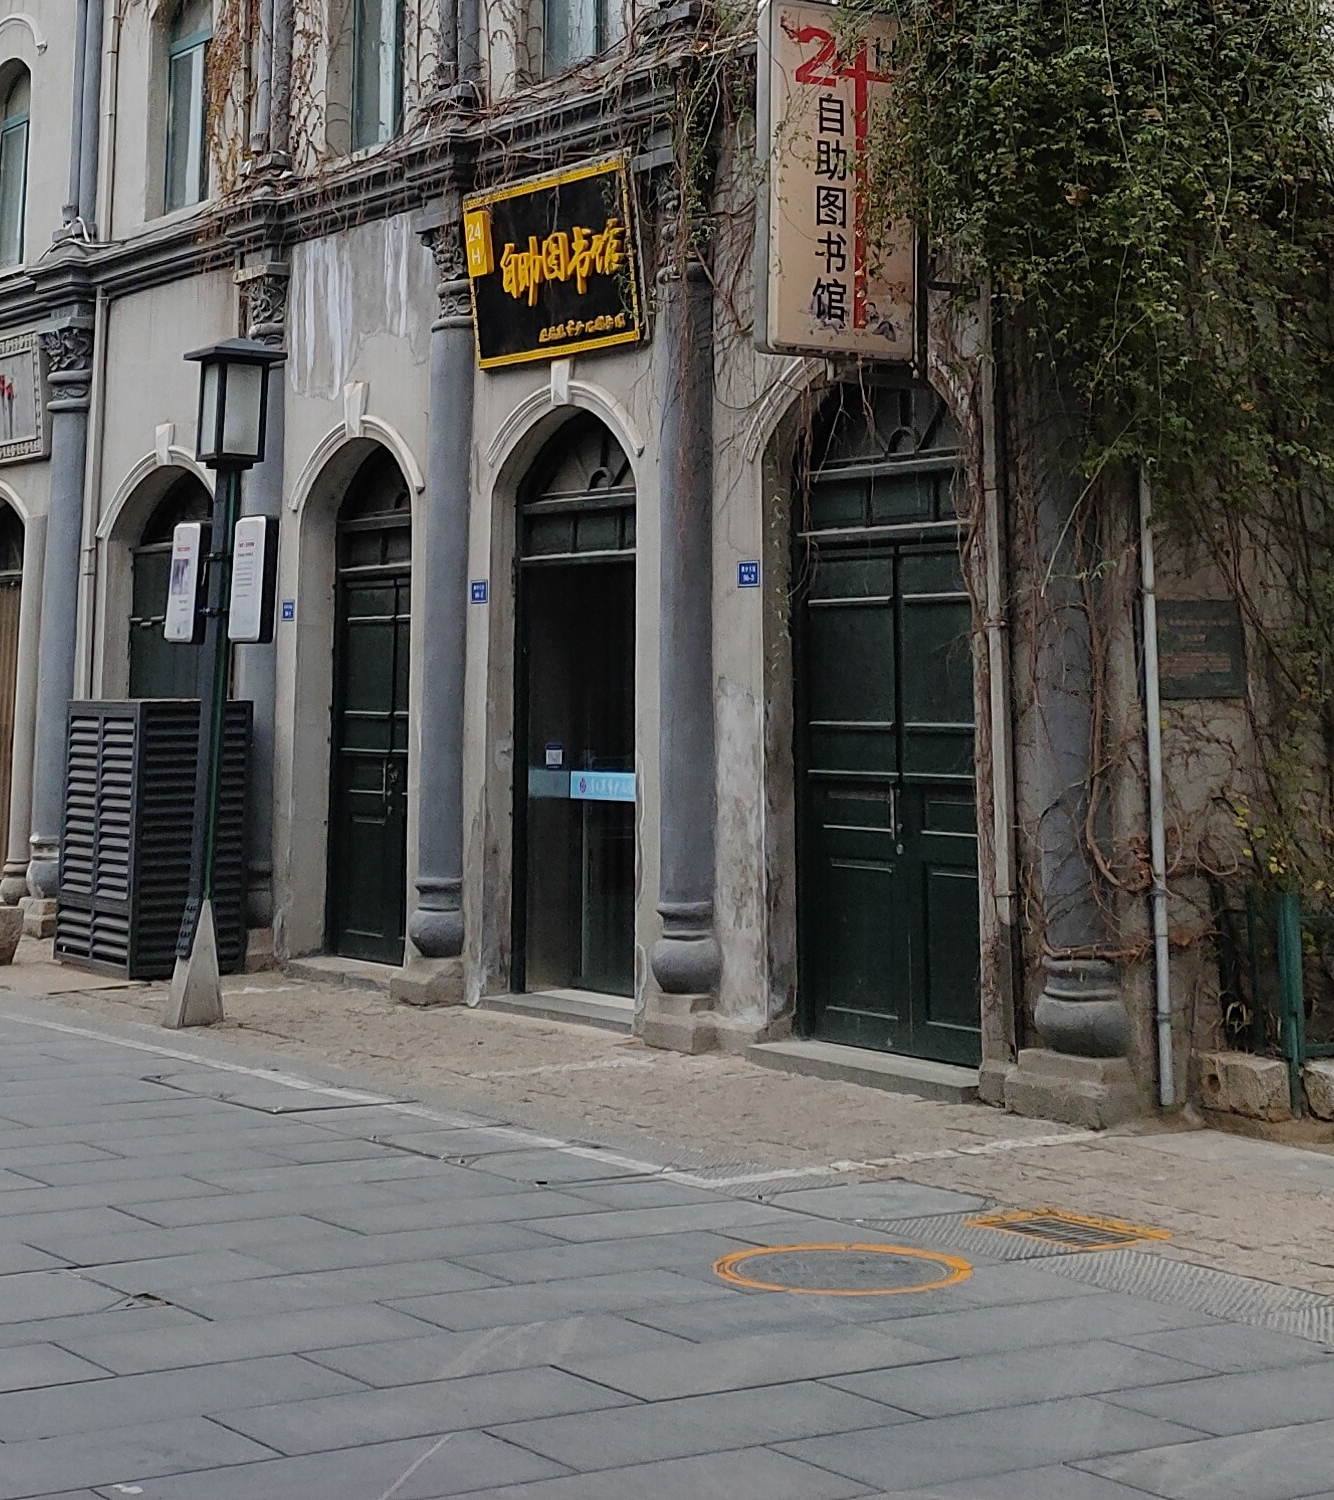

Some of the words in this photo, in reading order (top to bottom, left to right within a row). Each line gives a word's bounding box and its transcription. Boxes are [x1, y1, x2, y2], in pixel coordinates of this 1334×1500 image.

[468, 222, 482, 243] 24
[814, 93, 848, 322] 自助图书馆
[472, 246, 482, 266] H
[500, 217, 627, 307] 自助图书馆
